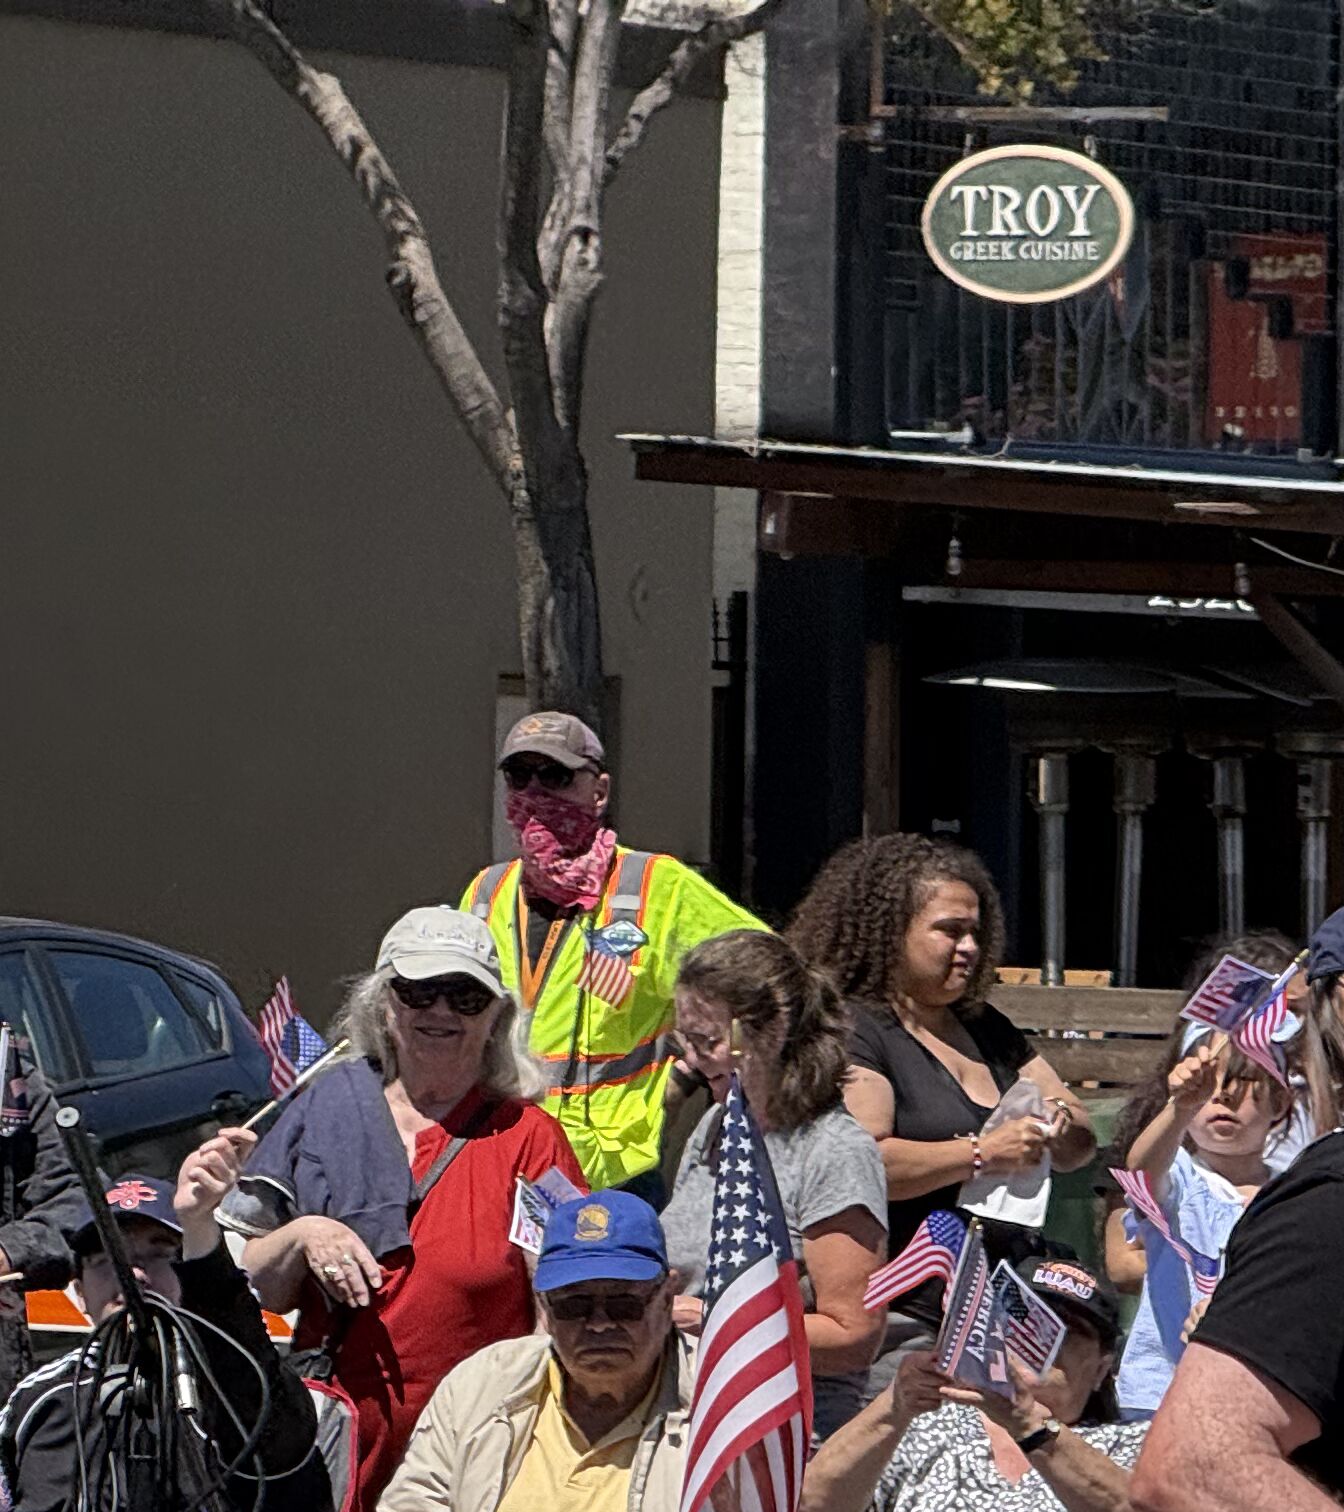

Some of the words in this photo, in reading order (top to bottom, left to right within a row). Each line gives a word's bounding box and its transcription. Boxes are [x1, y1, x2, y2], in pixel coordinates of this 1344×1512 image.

[950, 184, 1100, 239] TROY
[949, 241, 1015, 261] GREEK
[1018, 242, 1100, 262] CUISINE
